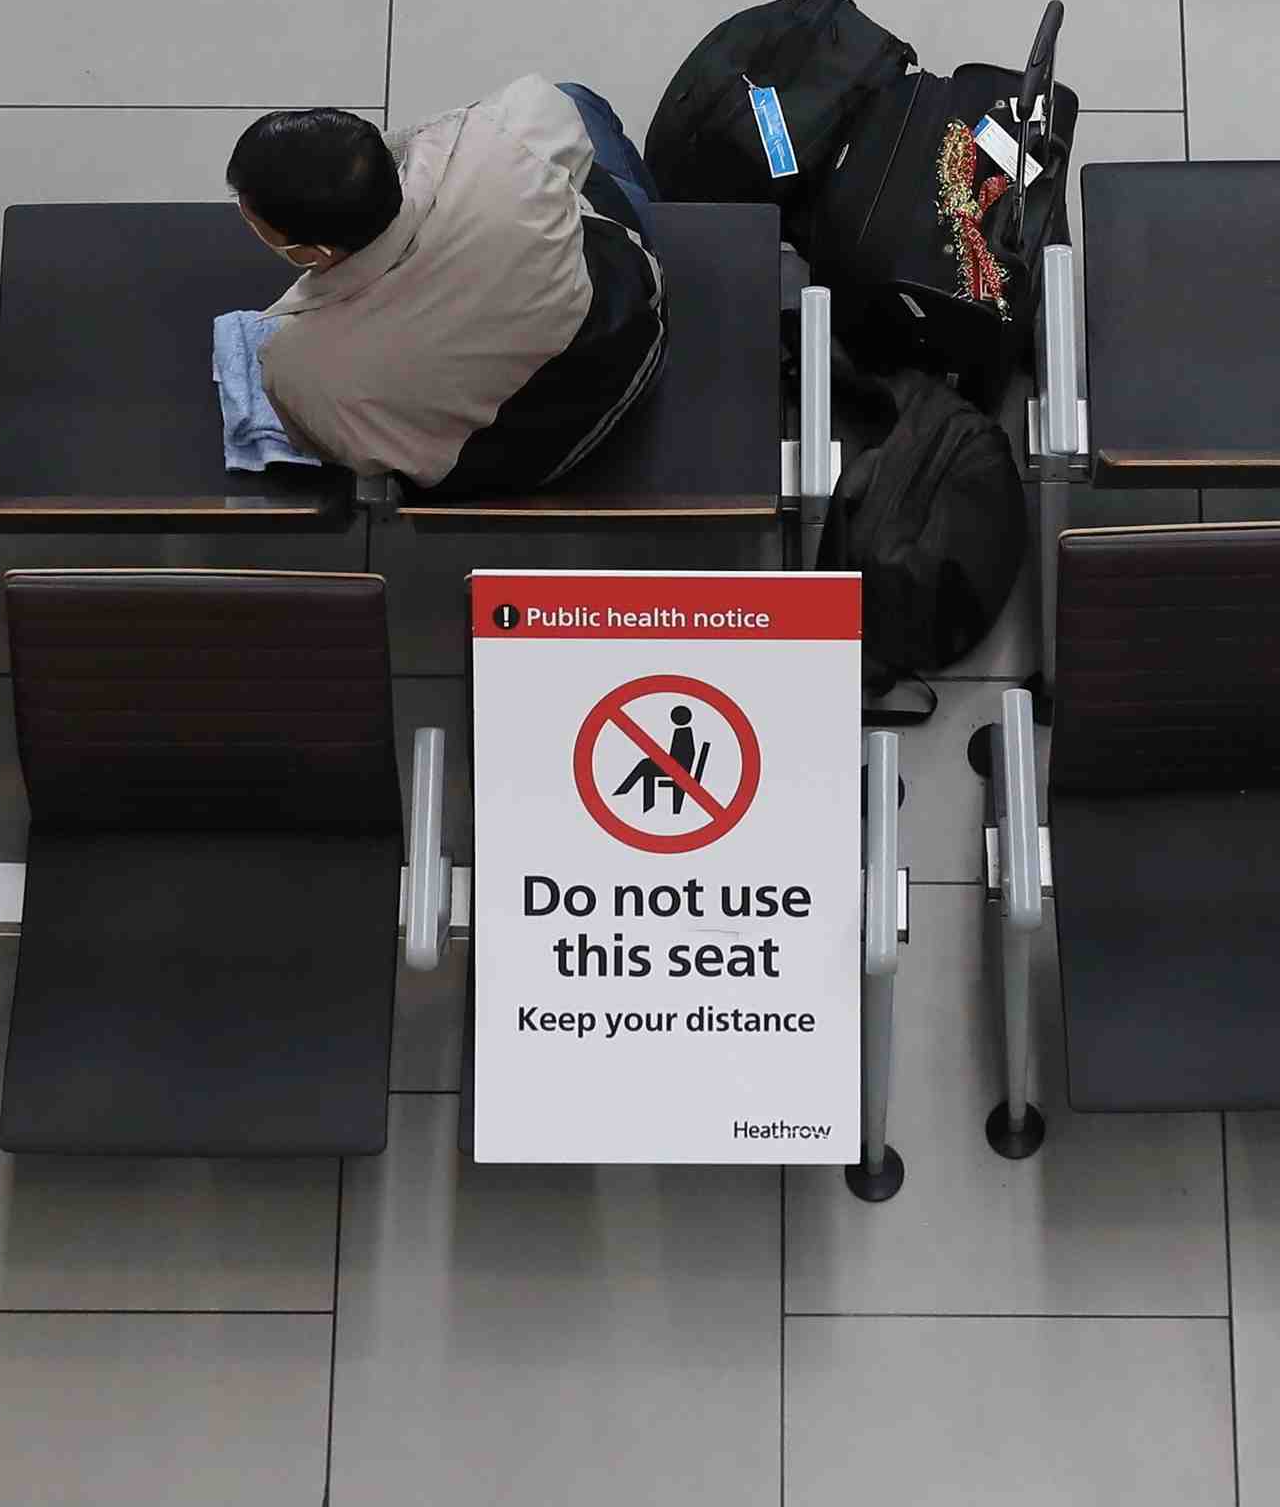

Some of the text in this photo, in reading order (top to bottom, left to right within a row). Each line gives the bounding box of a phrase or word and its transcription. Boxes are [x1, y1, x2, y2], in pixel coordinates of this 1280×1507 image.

[528, 607, 769, 627] Public health notice
[524, 876, 811, 917] Do not use
[553, 933, 779, 977] this seat
[519, 1006, 815, 1038] Keep your distance
[734, 1120, 831, 1139] Heathrow
